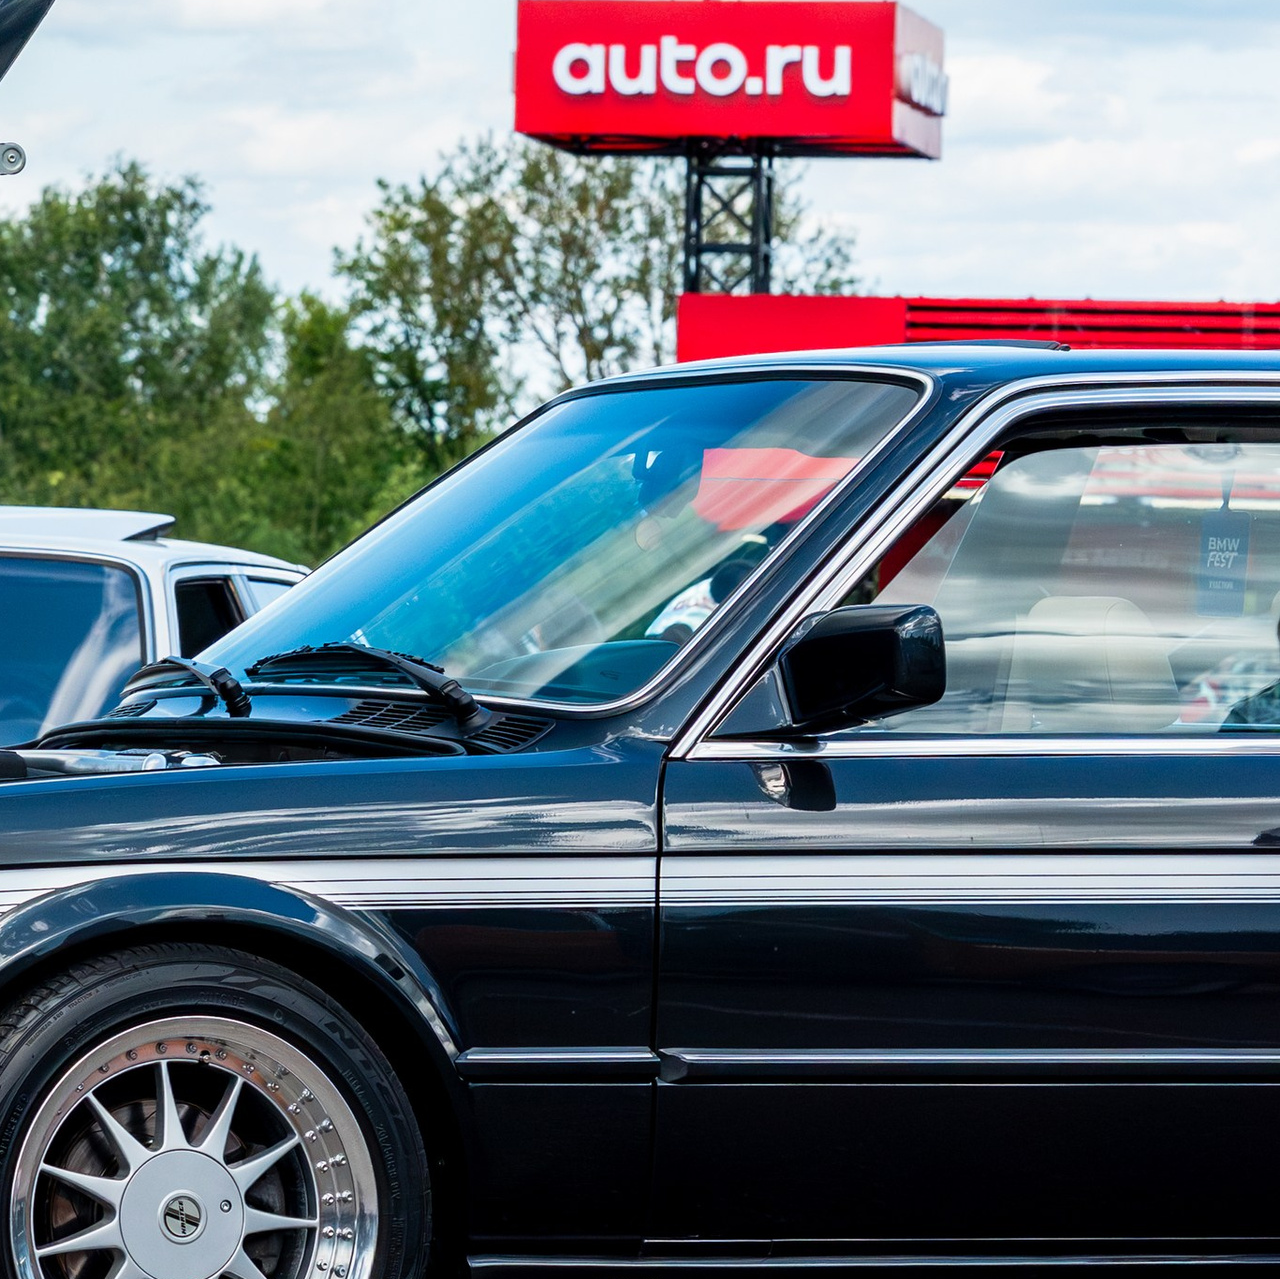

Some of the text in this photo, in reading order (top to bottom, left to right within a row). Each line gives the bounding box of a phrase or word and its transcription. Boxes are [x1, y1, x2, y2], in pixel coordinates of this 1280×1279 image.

[552, 35, 852, 98] auto.ru
[1208, 537, 1240, 551] BMW
[1207, 551, 1239, 569] FEST
